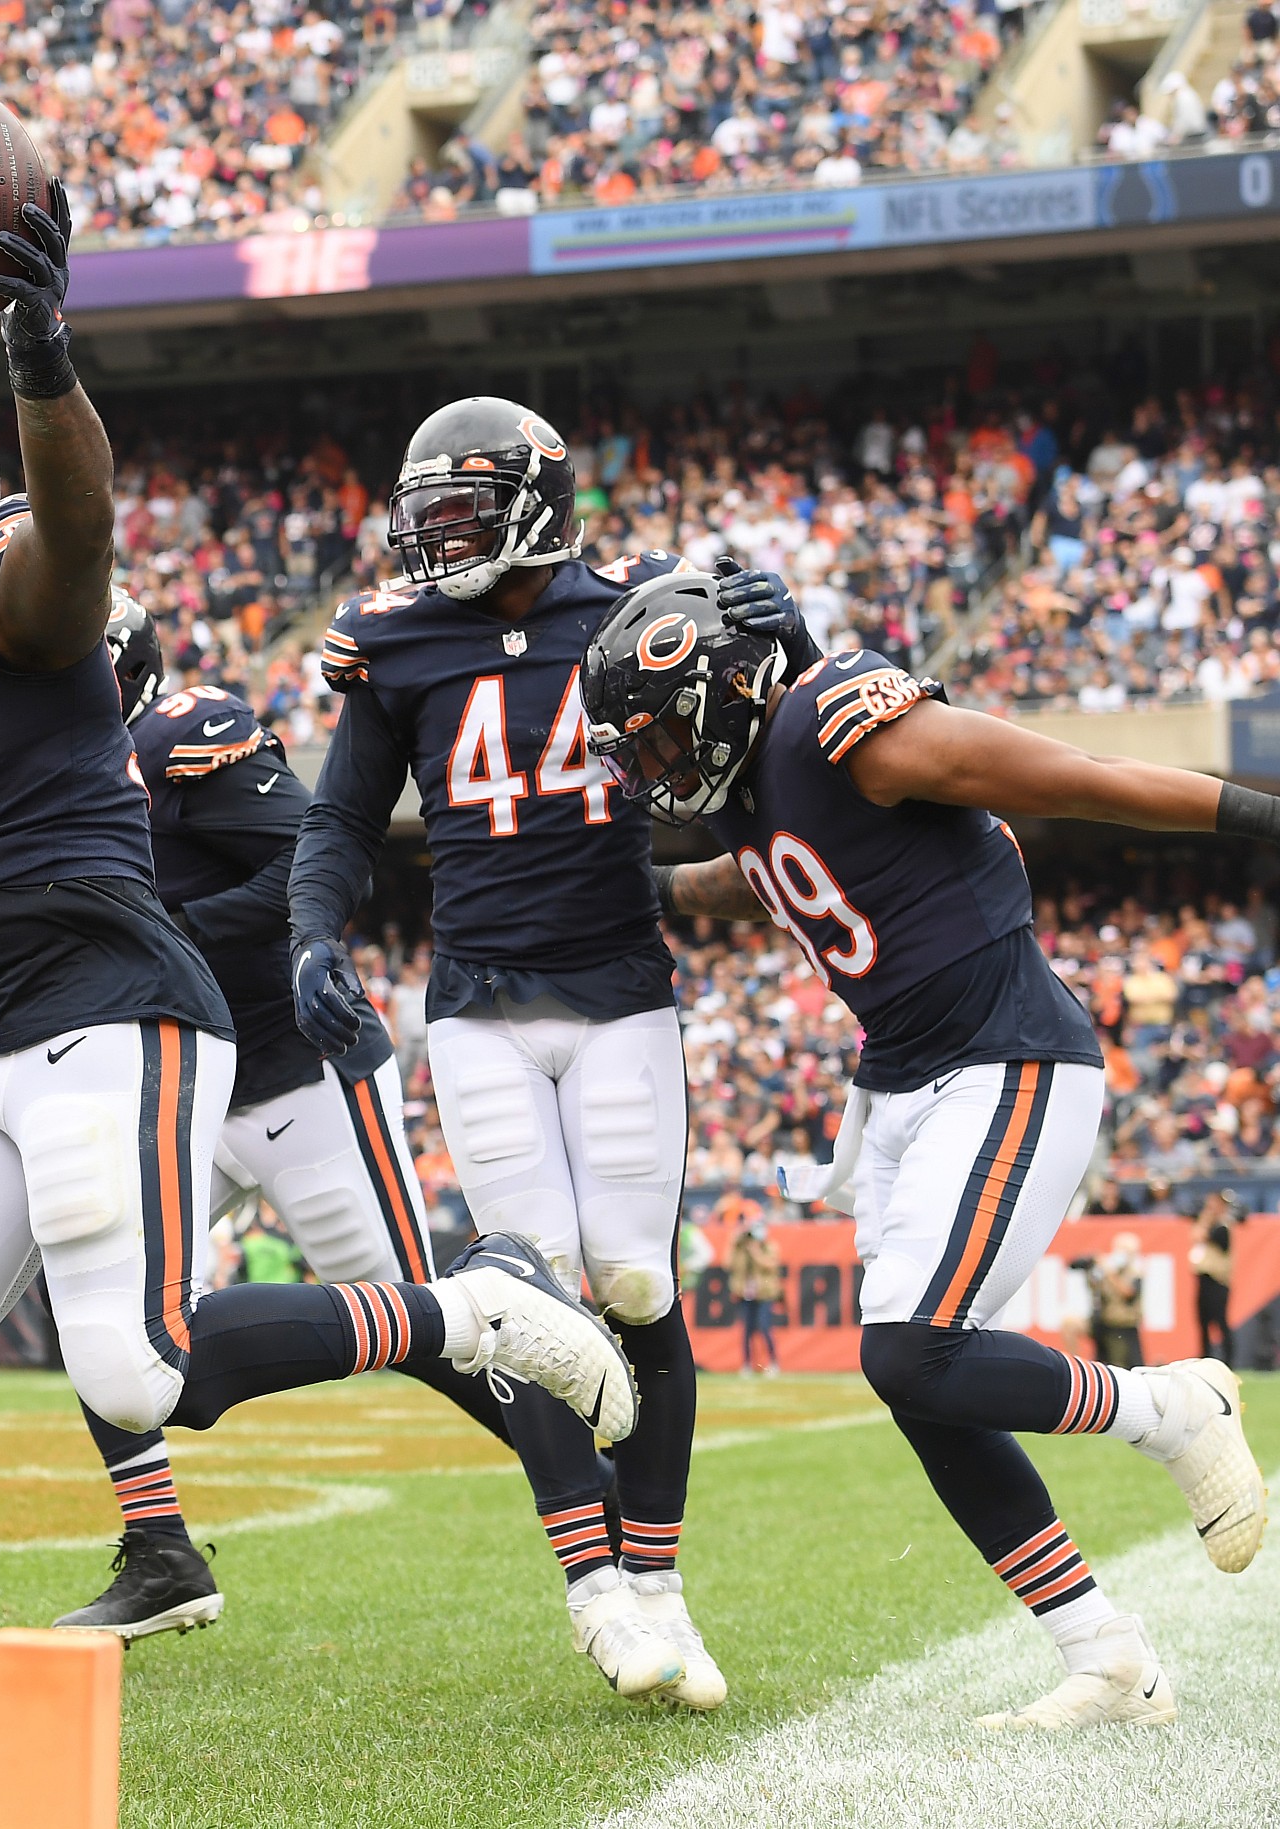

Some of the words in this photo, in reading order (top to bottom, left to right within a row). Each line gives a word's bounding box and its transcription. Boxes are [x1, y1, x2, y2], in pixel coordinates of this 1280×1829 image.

[0, 122, 14, 152] LEAGUE
[9, 155, 19, 201] FOOTBALL
[1239, 155, 1272, 208] 0
[885, 193, 943, 236] NFL
[957, 184, 1078, 231] Scores
[446, 664, 622, 837] 44
[737, 830, 878, 990] 99
